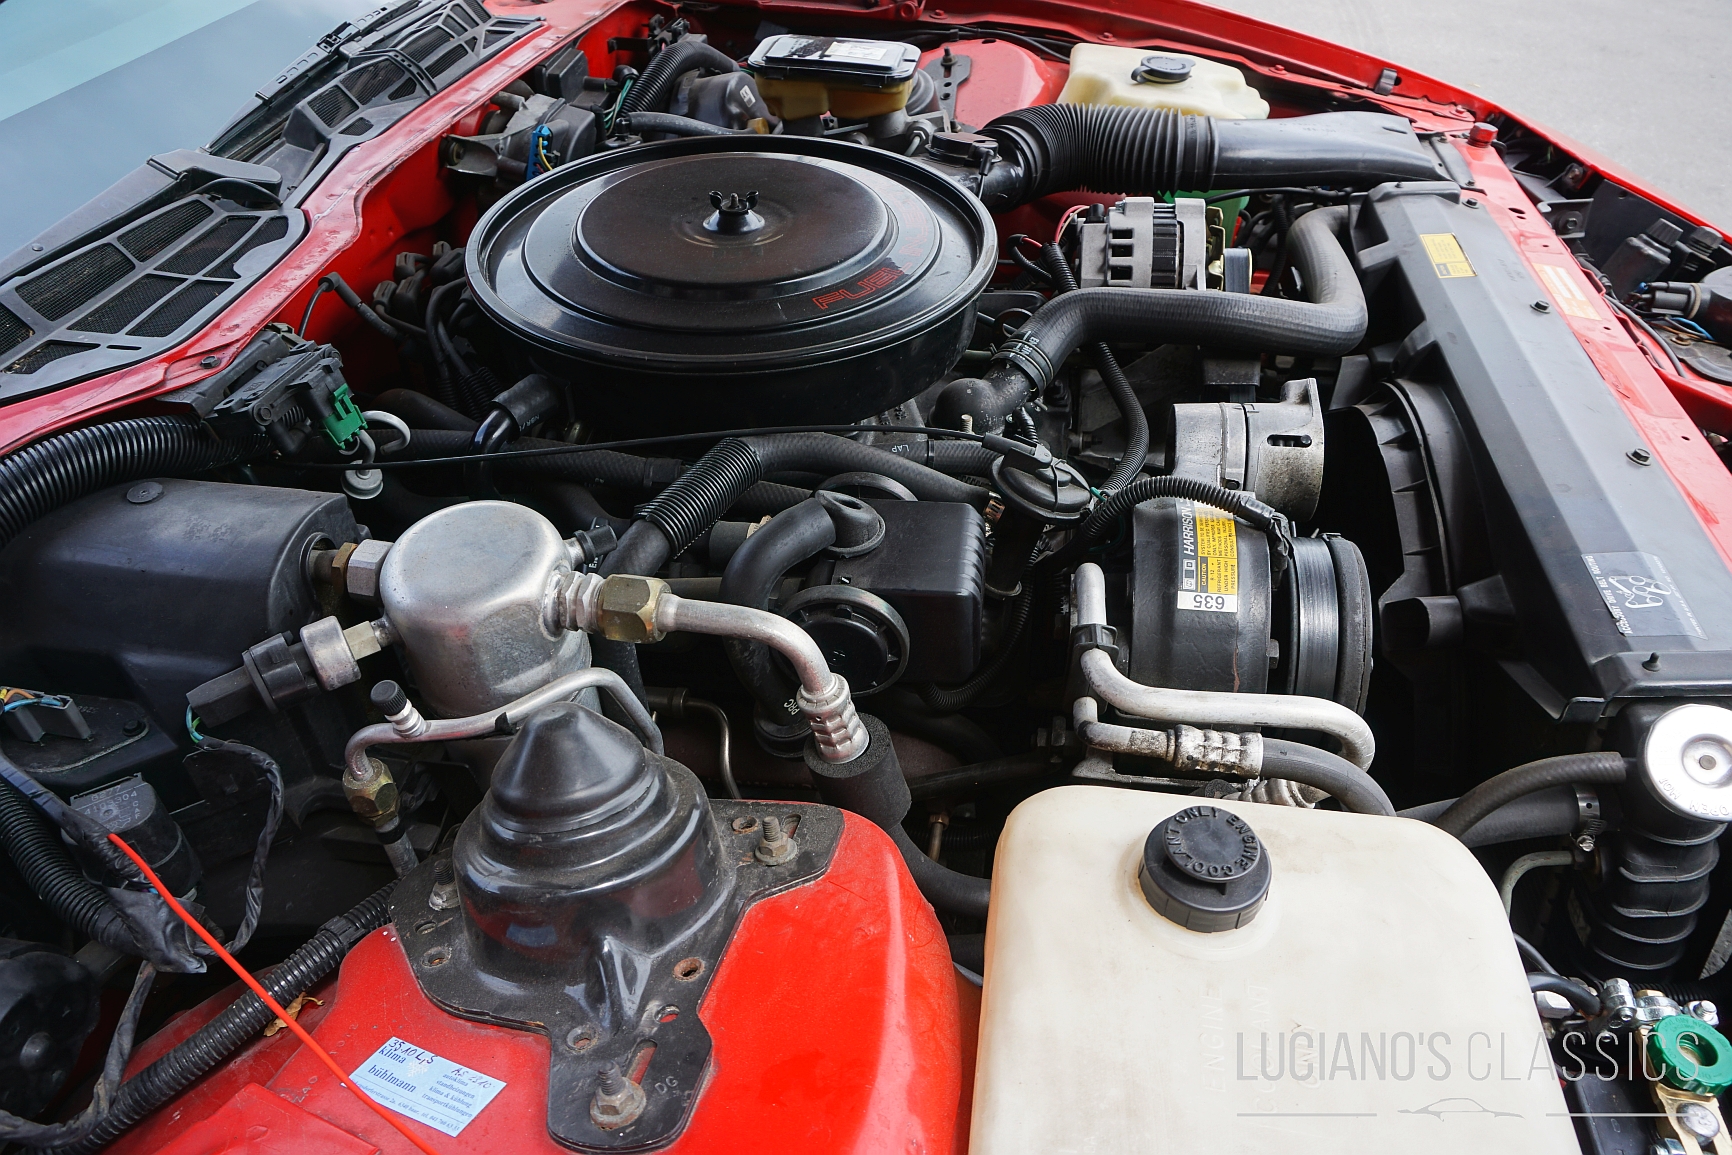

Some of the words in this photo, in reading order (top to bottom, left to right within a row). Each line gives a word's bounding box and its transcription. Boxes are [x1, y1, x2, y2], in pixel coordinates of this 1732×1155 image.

[811, 262, 913, 310] FUEL
[1182, 507, 1195, 555] HARRISON
[1193, 594, 1225, 610] 635
[1174, 806, 1222, 824] ONLY
[1165, 828, 1235, 877] COOLANT
[1226, 813, 1259, 871] ENGINE
[378, 1045, 407, 1064] klima
[368, 1065, 417, 1093] bühlmann
